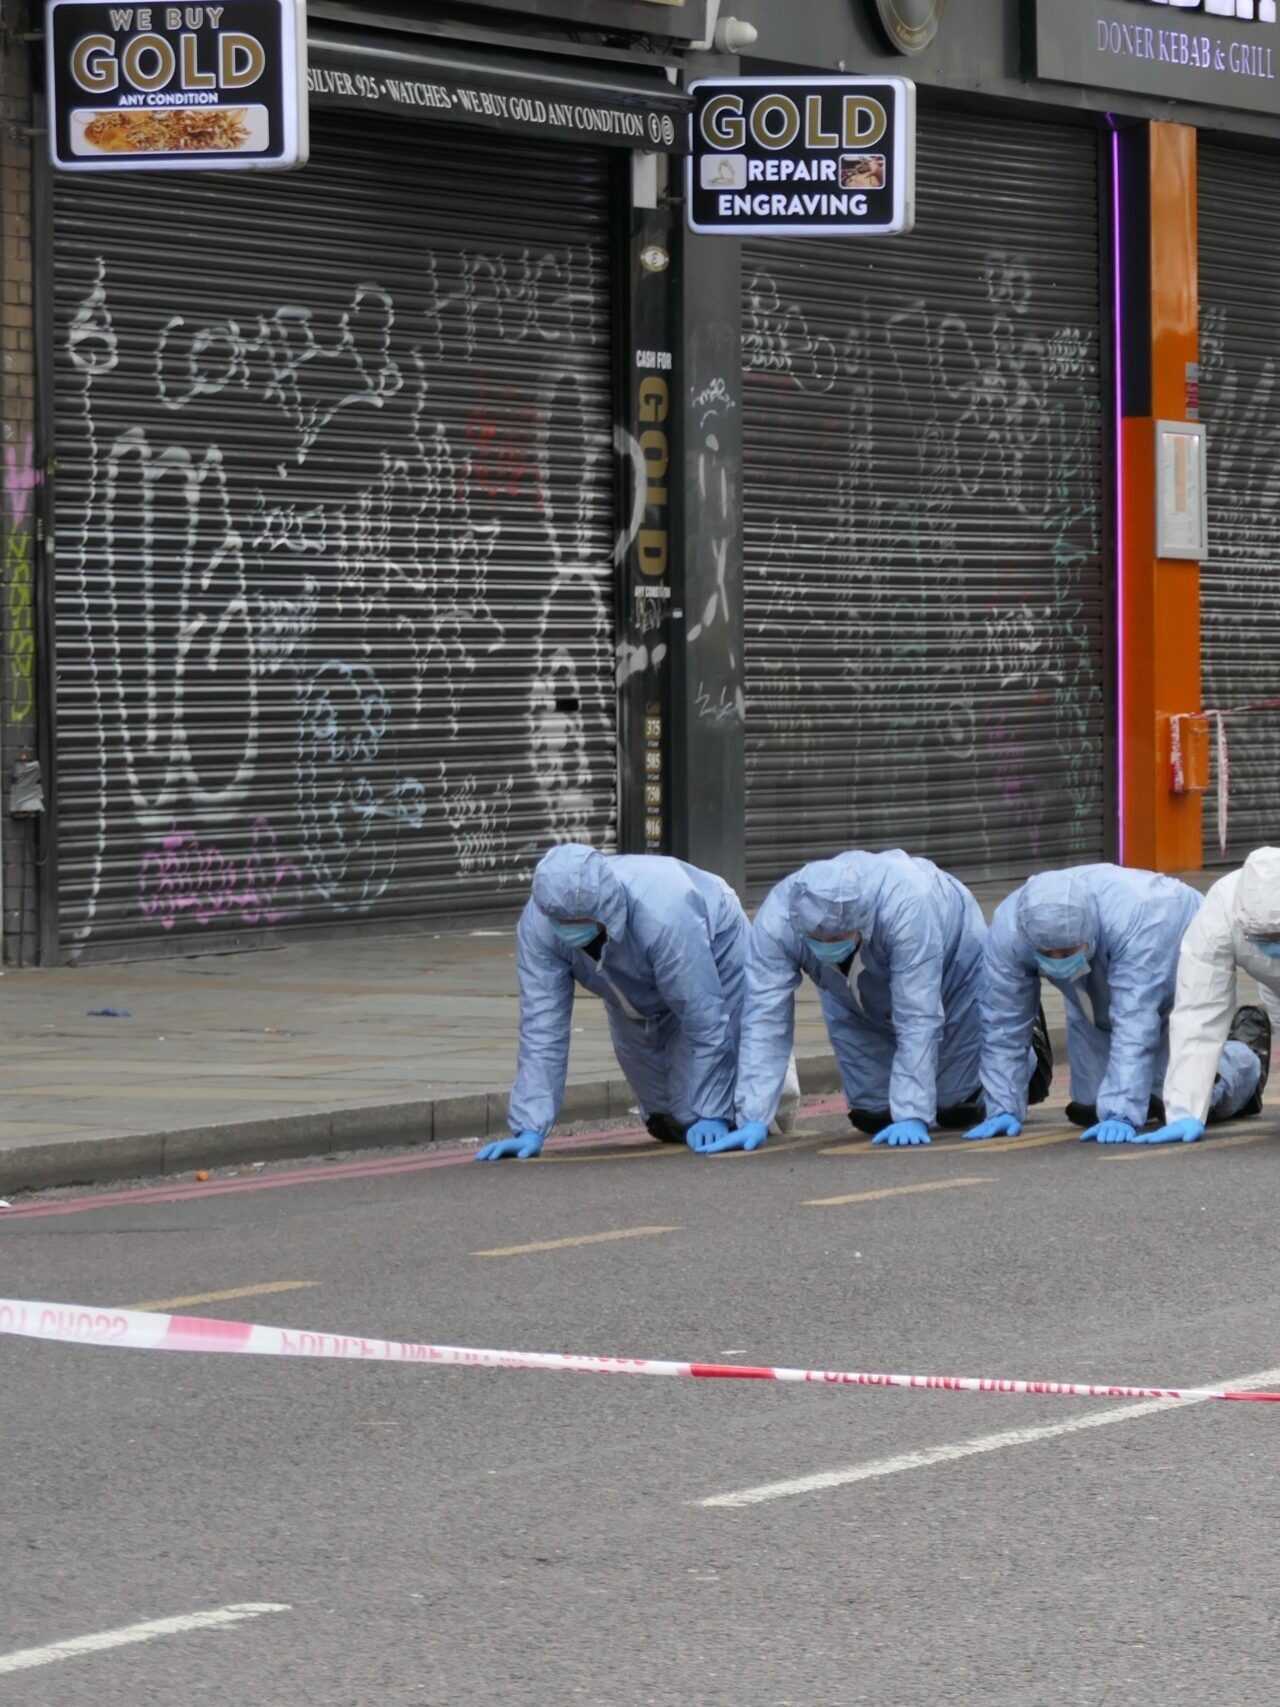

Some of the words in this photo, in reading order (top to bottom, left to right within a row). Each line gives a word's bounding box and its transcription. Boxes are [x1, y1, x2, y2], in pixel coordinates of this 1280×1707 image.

[110, 9, 152, 31] WE
[166, 7, 224, 30] BUY
[71, 32, 265, 94] GOLD
[1097, 20, 1154, 59] DONER
[1159, 30, 1210, 68] KEBAB
[1214, 40, 1226, 71] &
[1229, 43, 1275, 78] GRILL
[118, 93, 146, 106] ANY
[147, 92, 218, 105] CONDITION
[307, 68, 358, 96] SILVER
[355, 74, 379, 99] 925
[386, 79, 451, 108] WATCHES
[456, 89, 482, 113] WE
[482, 92, 510, 117] BUY
[509, 97, 546, 123] GOLD
[548, 103, 574, 127] ANY
[574, 107, 644, 137] CONDITION
[700, 94, 887, 150] GOLD
[749, 159, 837, 181] REPAIR
[718, 194, 868, 216] ENGRAVING
[636, 349, 656, 368] CASH
[656, 351, 672, 370] FOR
[638, 376, 669, 575] GOLD
